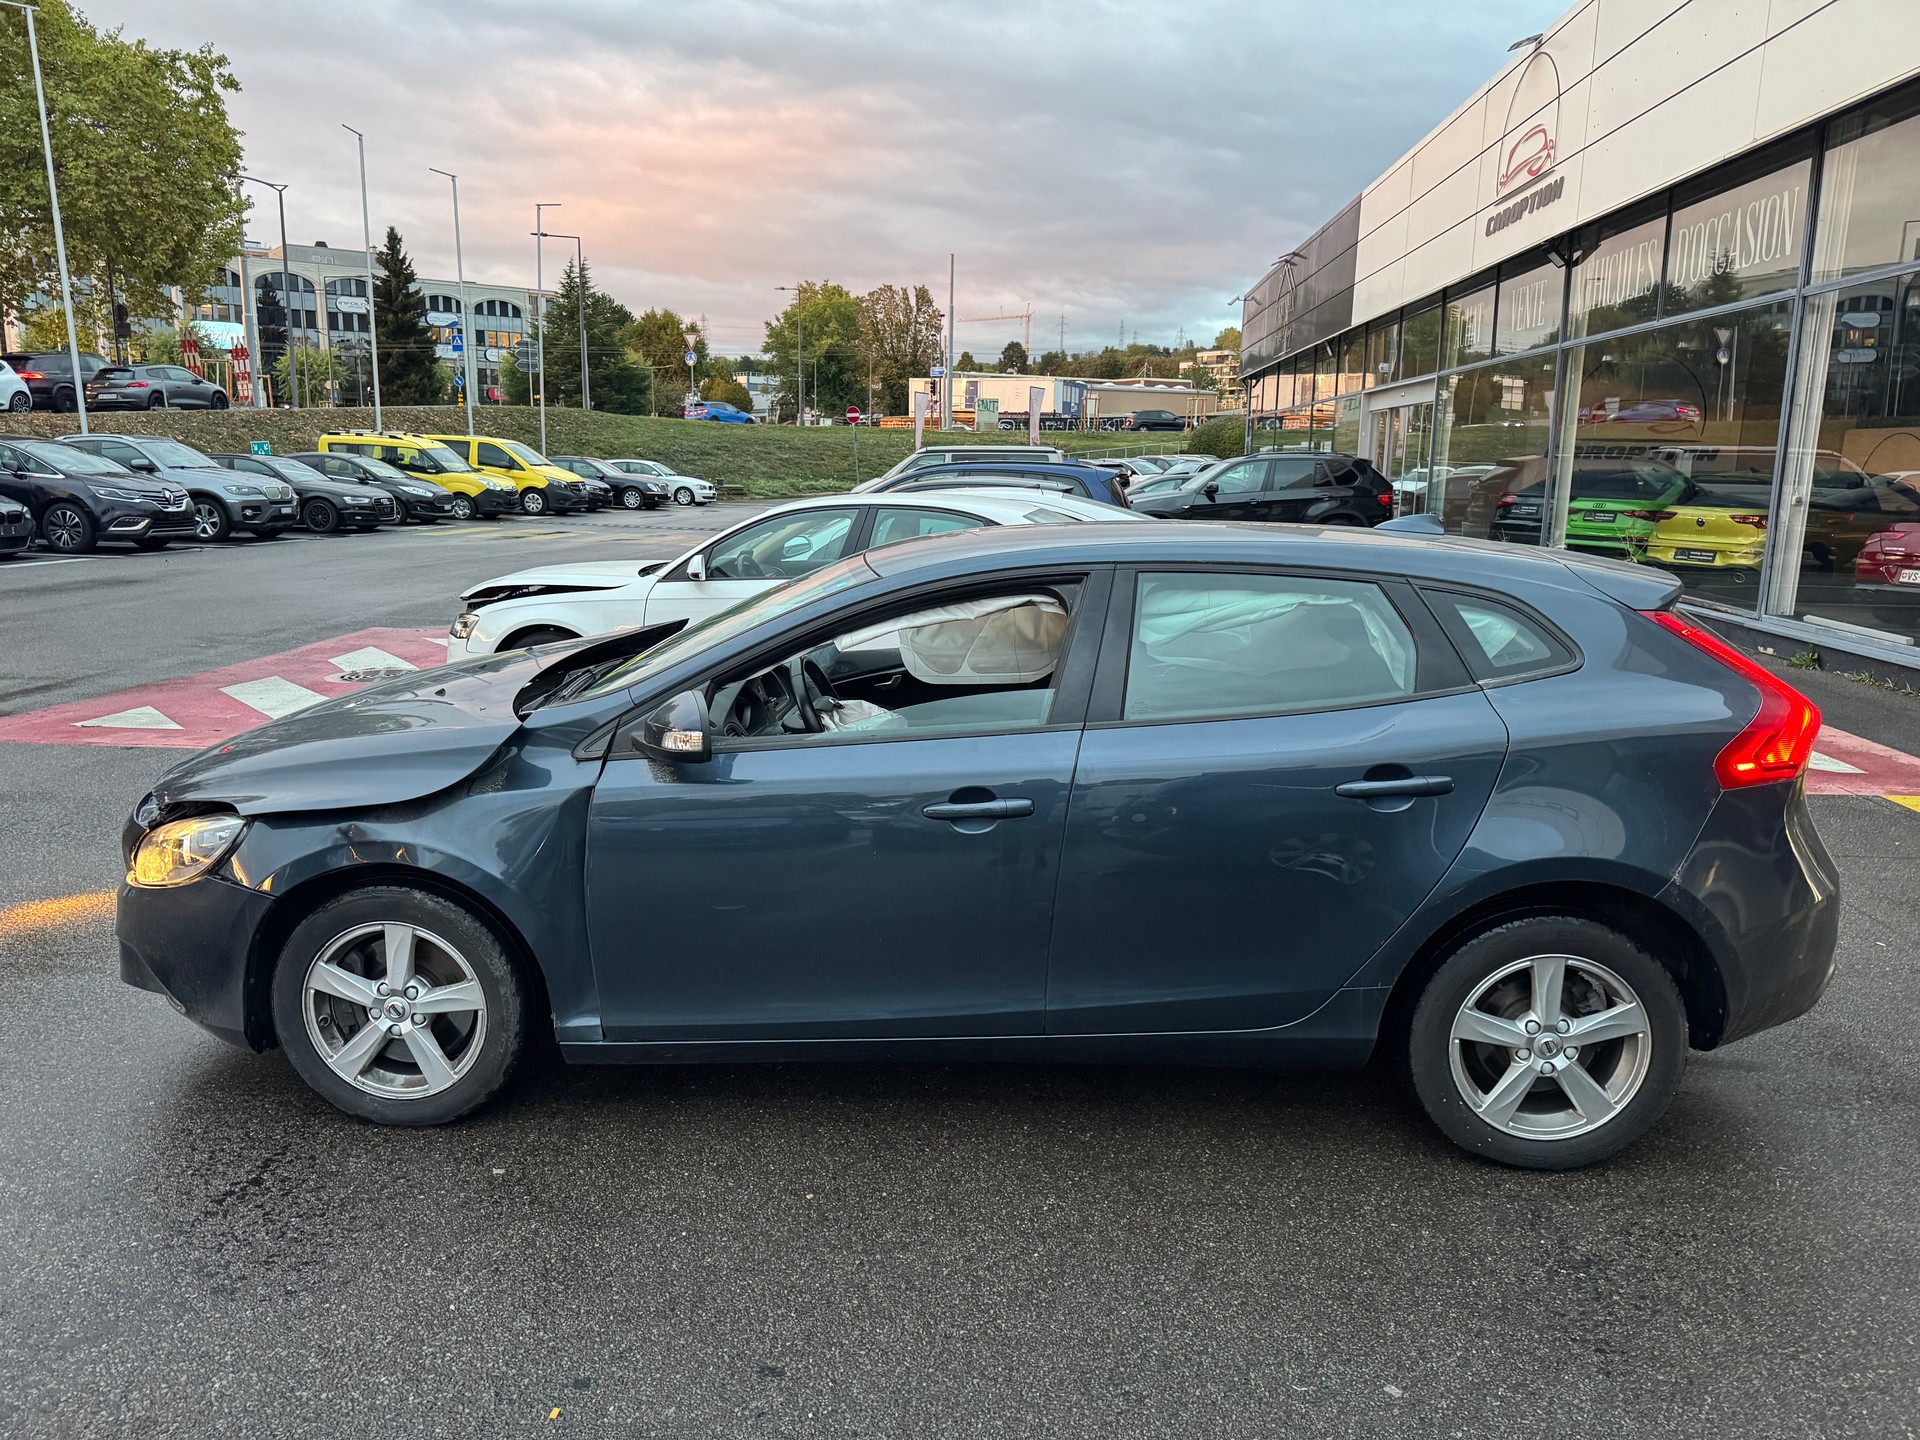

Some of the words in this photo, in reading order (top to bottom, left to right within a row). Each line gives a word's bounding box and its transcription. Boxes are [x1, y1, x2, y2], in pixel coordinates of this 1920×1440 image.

[1485, 175, 1565, 237] CAROPTION
[1512, 279, 1548, 333] VENTE
[1673, 187, 1799, 287] D'OCCASION
